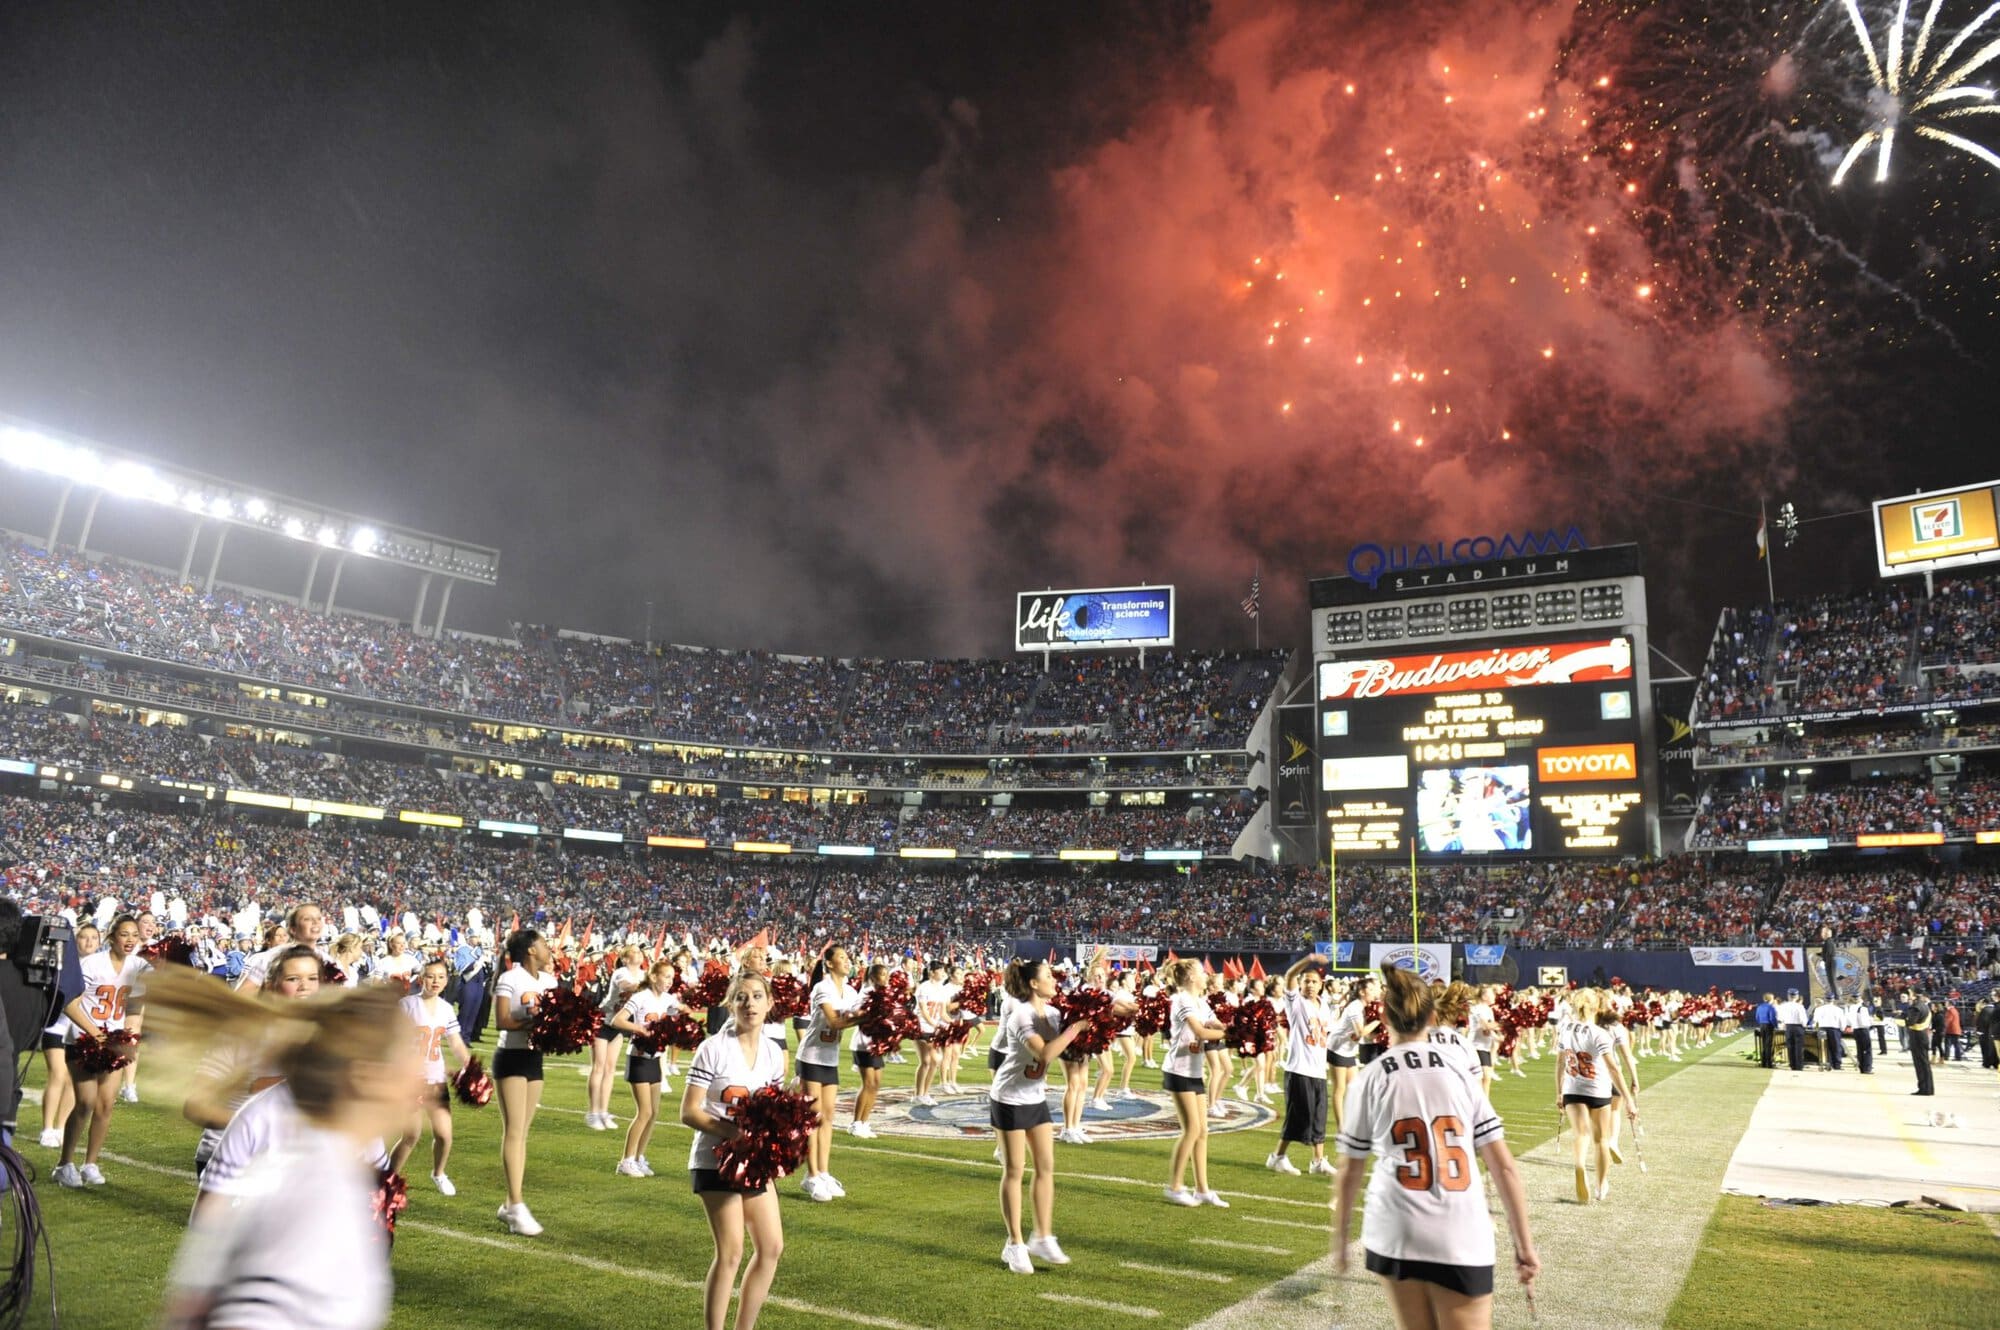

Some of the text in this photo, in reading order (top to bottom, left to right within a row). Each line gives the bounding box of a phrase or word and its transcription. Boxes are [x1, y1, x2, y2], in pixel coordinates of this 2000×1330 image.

[1347, 526, 1589, 589] QUALCOMM
[1396, 560, 1568, 588] STADIUM
[1102, 600, 1165, 611] Transforming
[1116, 610, 1150, 619] science
[1021, 597, 1070, 640] life
[1056, 628, 1112, 639] technologies
[1353, 648, 1551, 698] Budweiser
[1485, 692, 1503, 705] TO
[1424, 706, 1514, 724] DR PEPPER
[1882, 705, 1914, 713] OCATION
[1403, 723, 1489, 741] HALFTIME
[1280, 765, 1311, 778] Sprint
[1542, 754, 1631, 775] TOYOTA
[1771, 950, 1795, 970] N
[1381, 1050, 1445, 1075] BGA
[1391, 1115, 1472, 1191] 36
